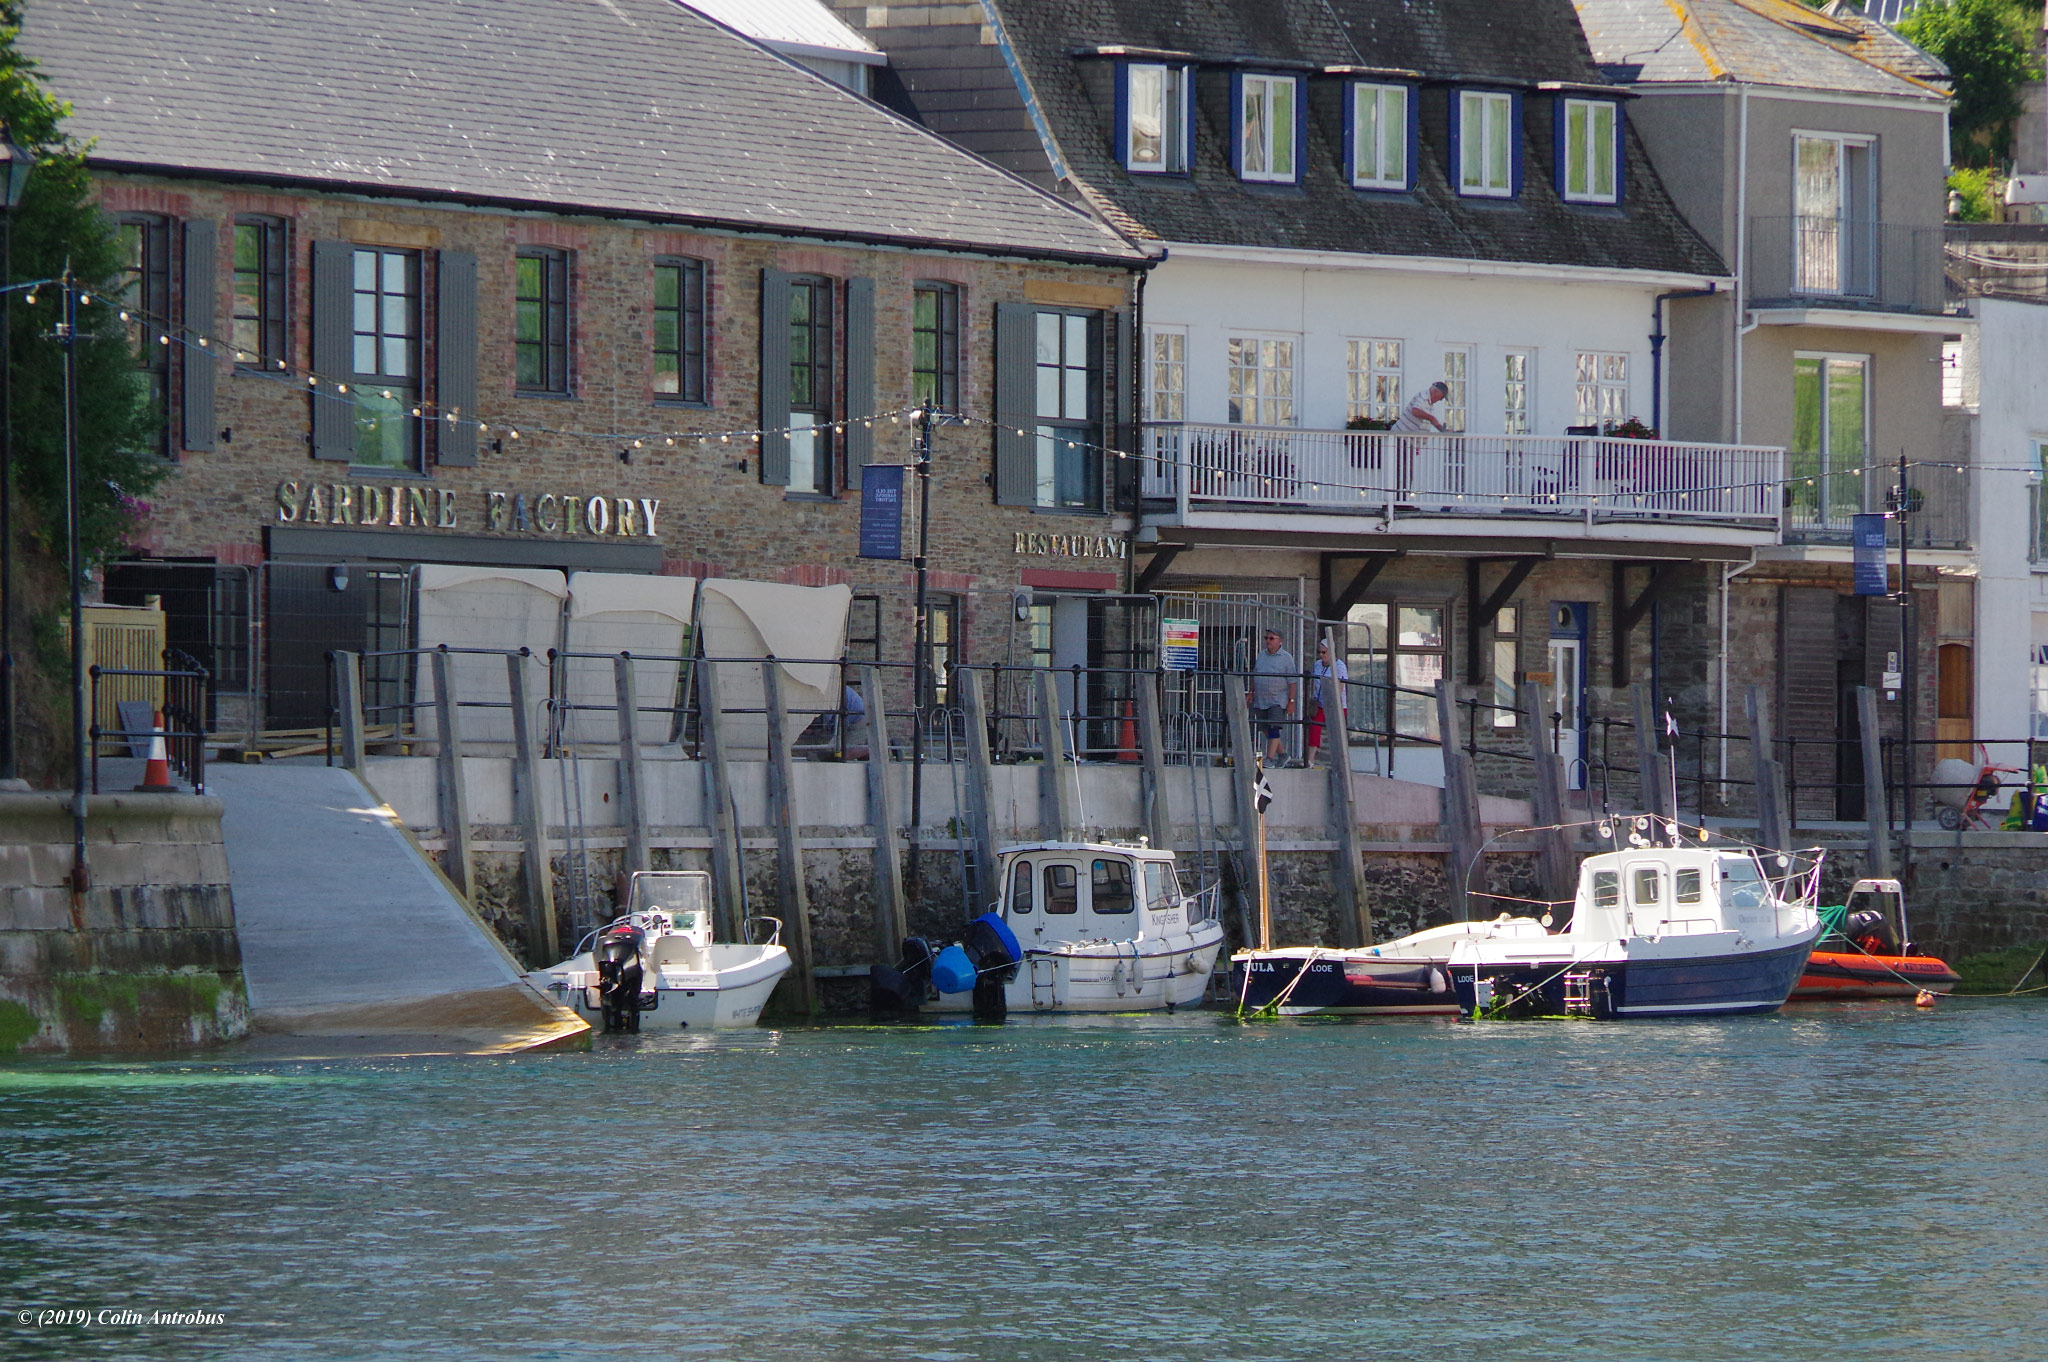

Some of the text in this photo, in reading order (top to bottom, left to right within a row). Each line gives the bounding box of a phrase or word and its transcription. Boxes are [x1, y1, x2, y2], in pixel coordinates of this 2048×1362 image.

[276, 480, 661, 537] SARDINE FACTORY
[1013, 532, 1126, 559] RESTAURANT
[1242, 962, 1275, 973] SULA
[1311, 964, 1333, 973] LOOE
[1457, 975, 1474, 983] LOOE
